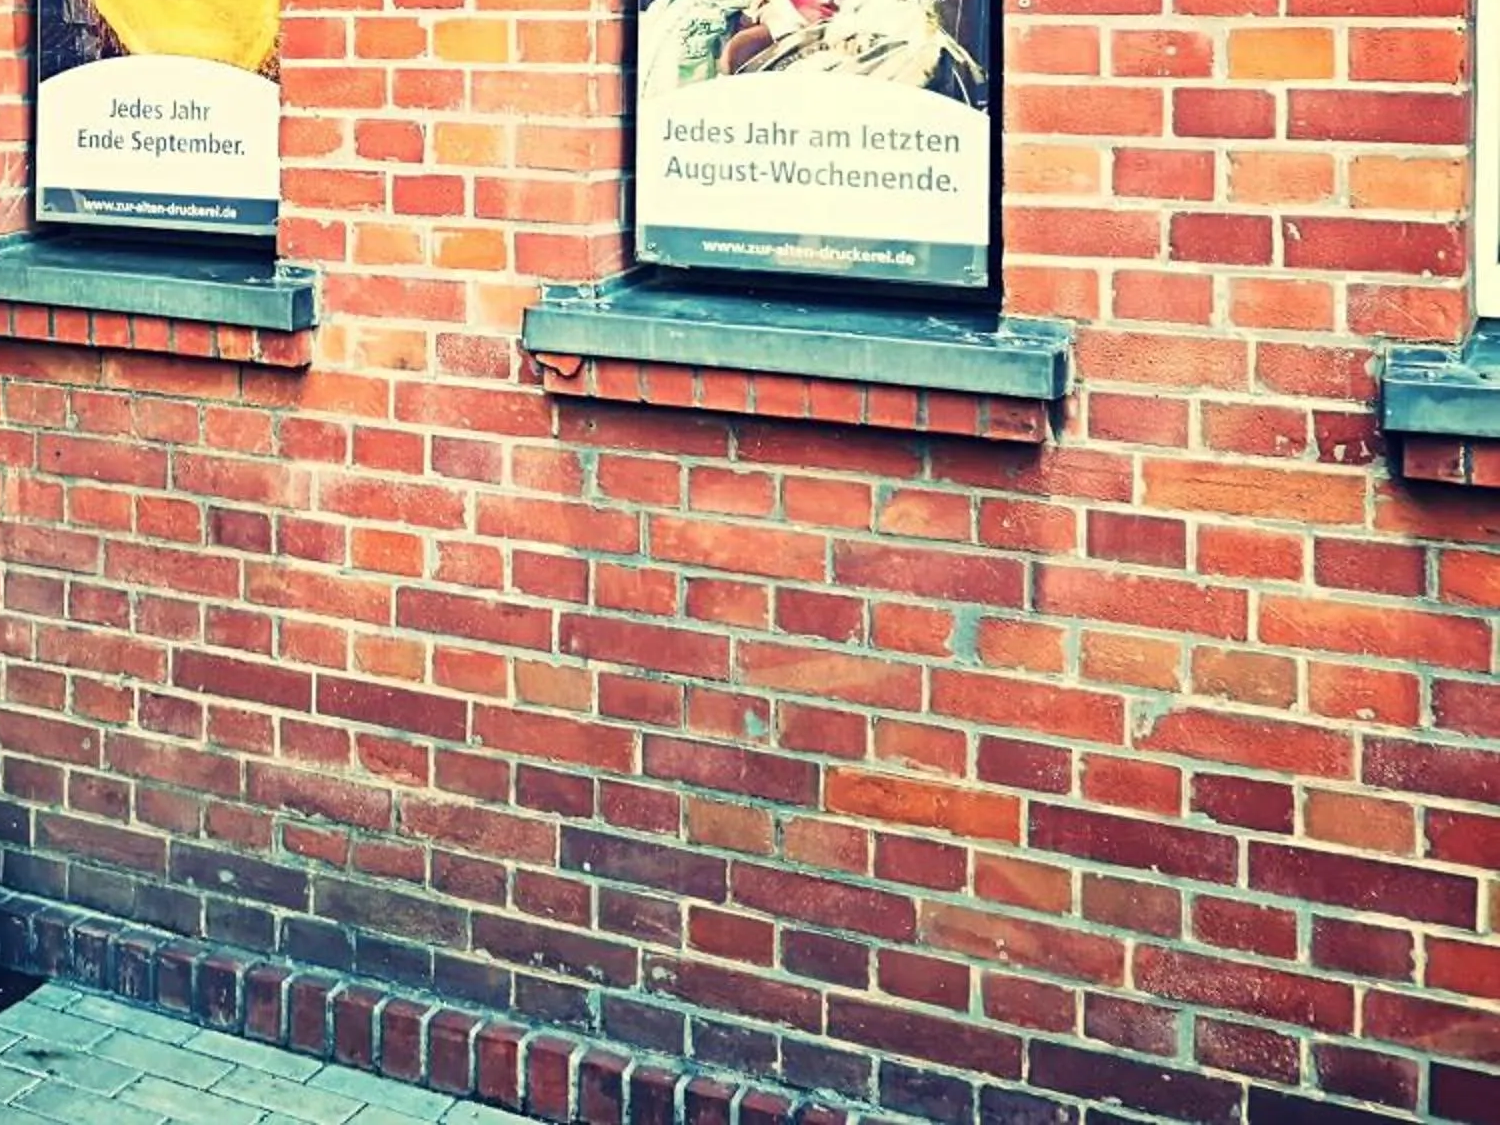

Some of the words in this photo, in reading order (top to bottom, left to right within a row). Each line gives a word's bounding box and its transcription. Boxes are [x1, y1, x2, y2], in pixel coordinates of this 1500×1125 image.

[109, 98, 164, 120] Jedes
[170, 99, 212, 122] Jahr
[77, 128, 125, 150] Ende
[131, 130, 246, 158] September.
[662, 118, 736, 144] Jedes
[744, 120, 800, 146] Jahr
[808, 129, 851, 149] am
[861, 124, 960, 154] letzten
[663, 154, 960, 194] August-Wochenende.
[702, 239, 915, 266] www.zur-alten-druckerei.de
